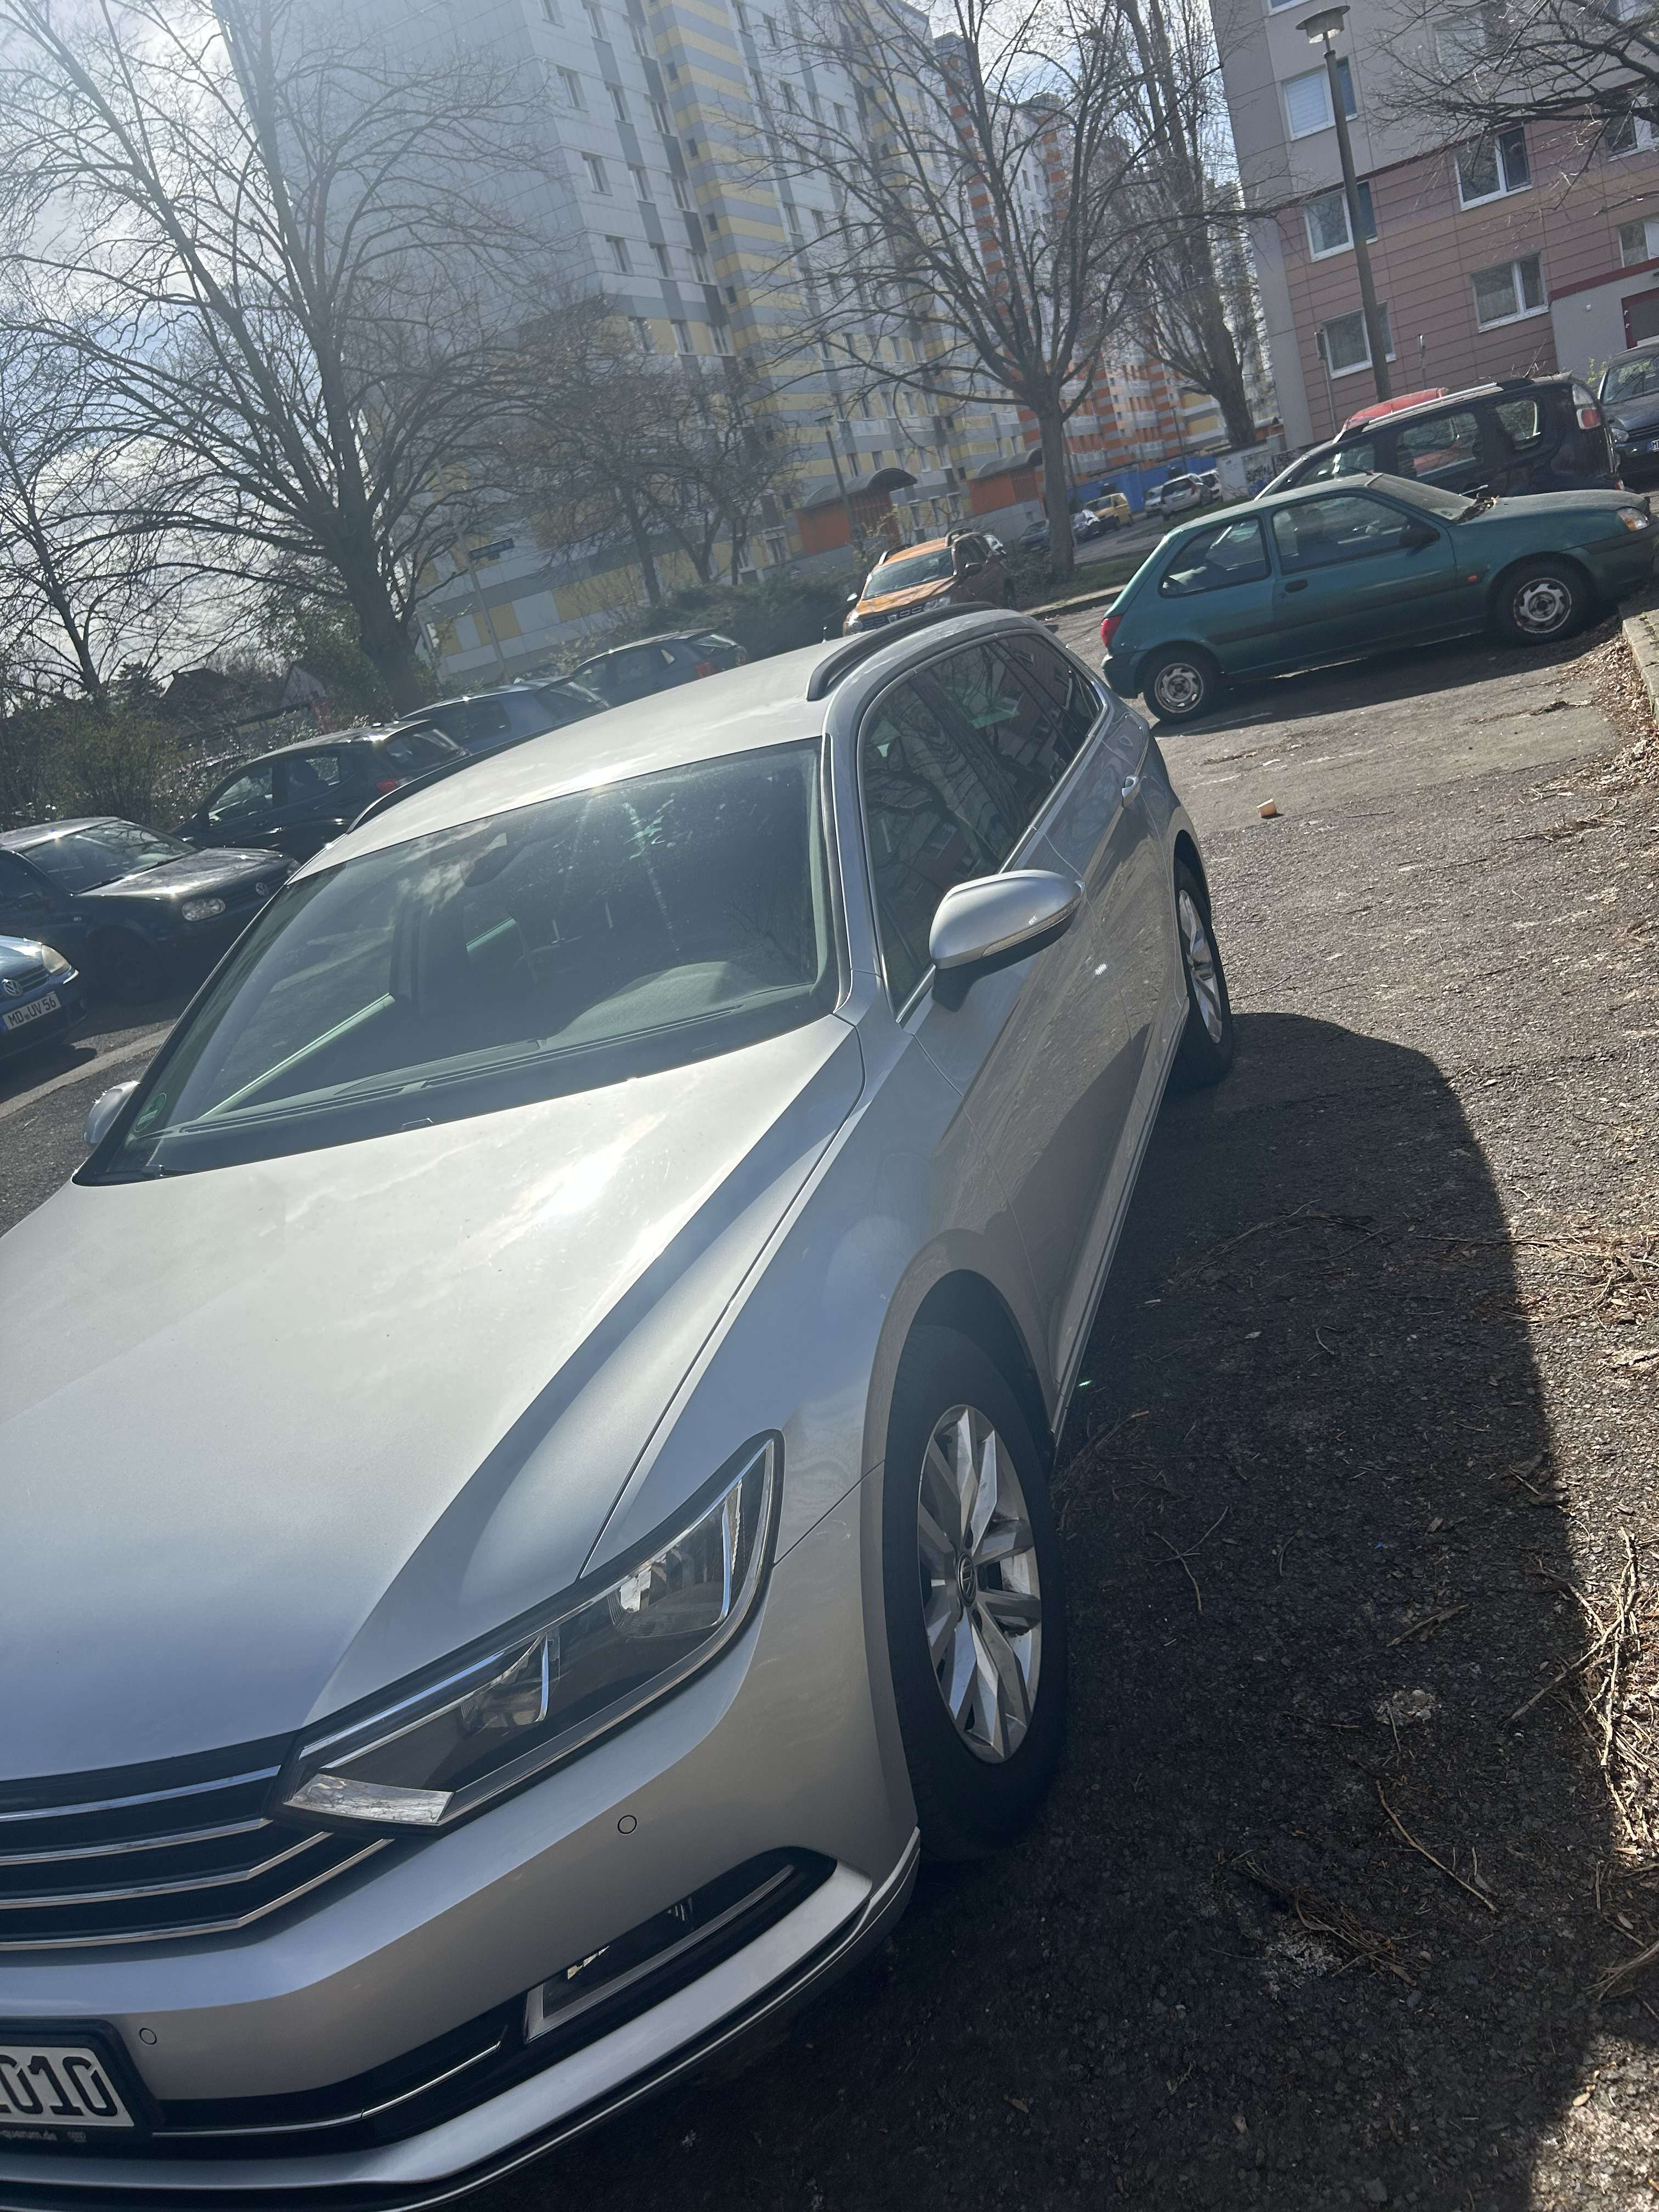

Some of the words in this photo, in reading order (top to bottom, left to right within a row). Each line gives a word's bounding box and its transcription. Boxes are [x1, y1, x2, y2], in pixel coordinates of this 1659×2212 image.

[8, 1010, 24, 1026] MD
[27, 1002, 42, 1017] UV
[42, 997, 56, 1011] 56
[0, 2054, 118, 2117] 010
